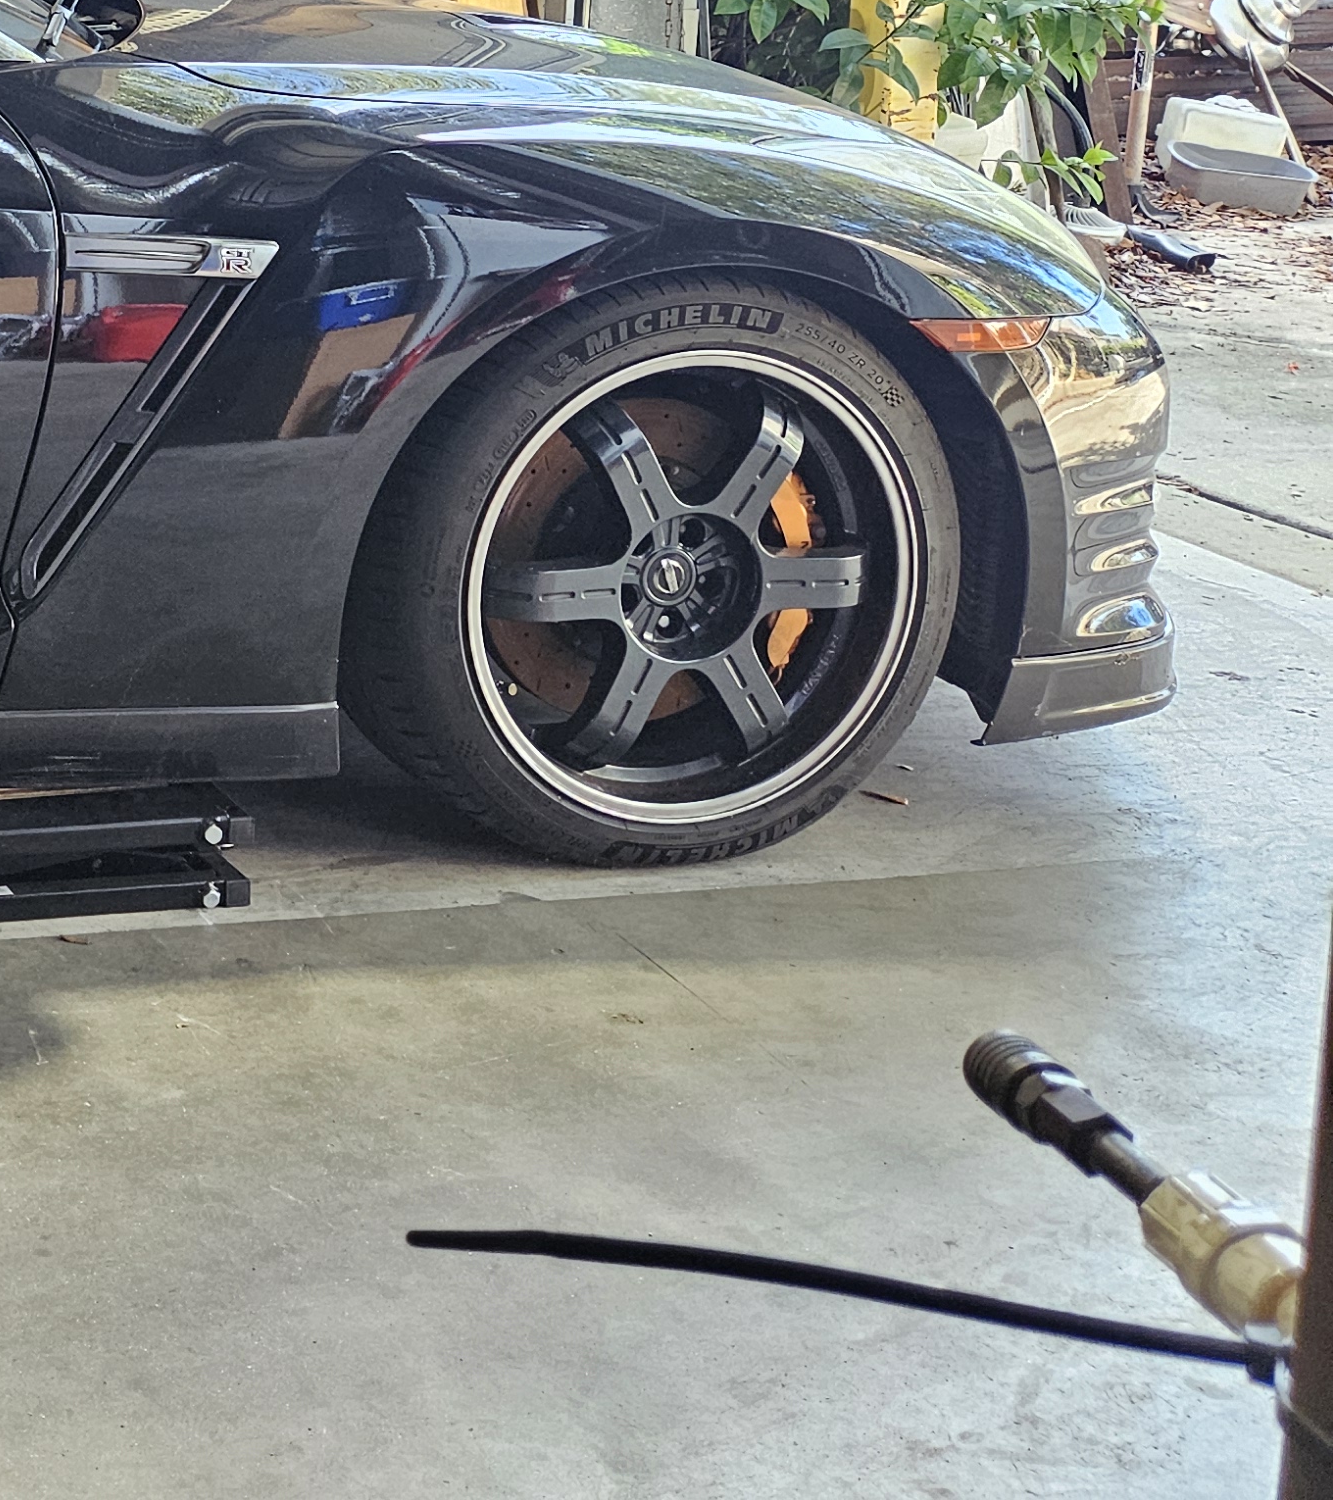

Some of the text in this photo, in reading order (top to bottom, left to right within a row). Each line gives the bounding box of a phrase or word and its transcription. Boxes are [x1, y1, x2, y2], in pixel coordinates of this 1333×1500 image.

[584, 304, 772, 357] MICHELIN
[795, 323, 845, 355] 255/40
[848, 349, 867, 370] ZR
